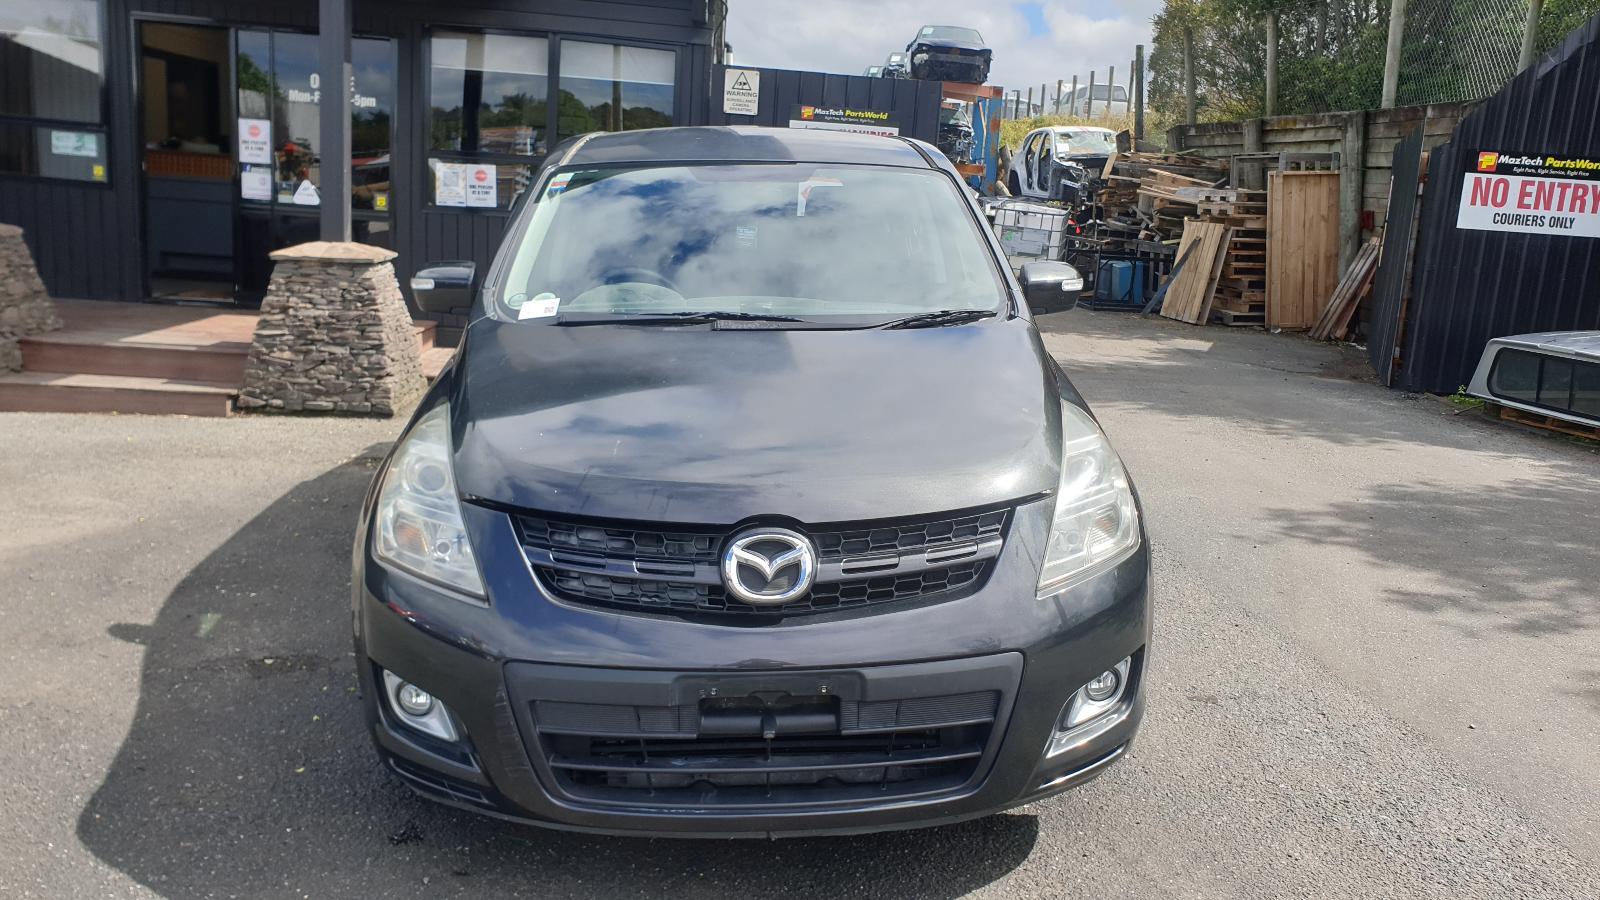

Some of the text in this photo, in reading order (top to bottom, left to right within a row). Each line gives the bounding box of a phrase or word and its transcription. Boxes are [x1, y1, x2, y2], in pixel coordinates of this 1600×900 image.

[289, 89, 377, 108] Mon-F -5pm
[726, 90, 758, 98] WARNING
[814, 107, 889, 120] MazTech PartsWorld
[1498, 154, 1543, 166] MazTech
[1545, 156, 1600, 170] PartsWor
[1470, 176, 1600, 214] NO ENTRY
[1493, 212, 1576, 229] COURIERS ONLY
